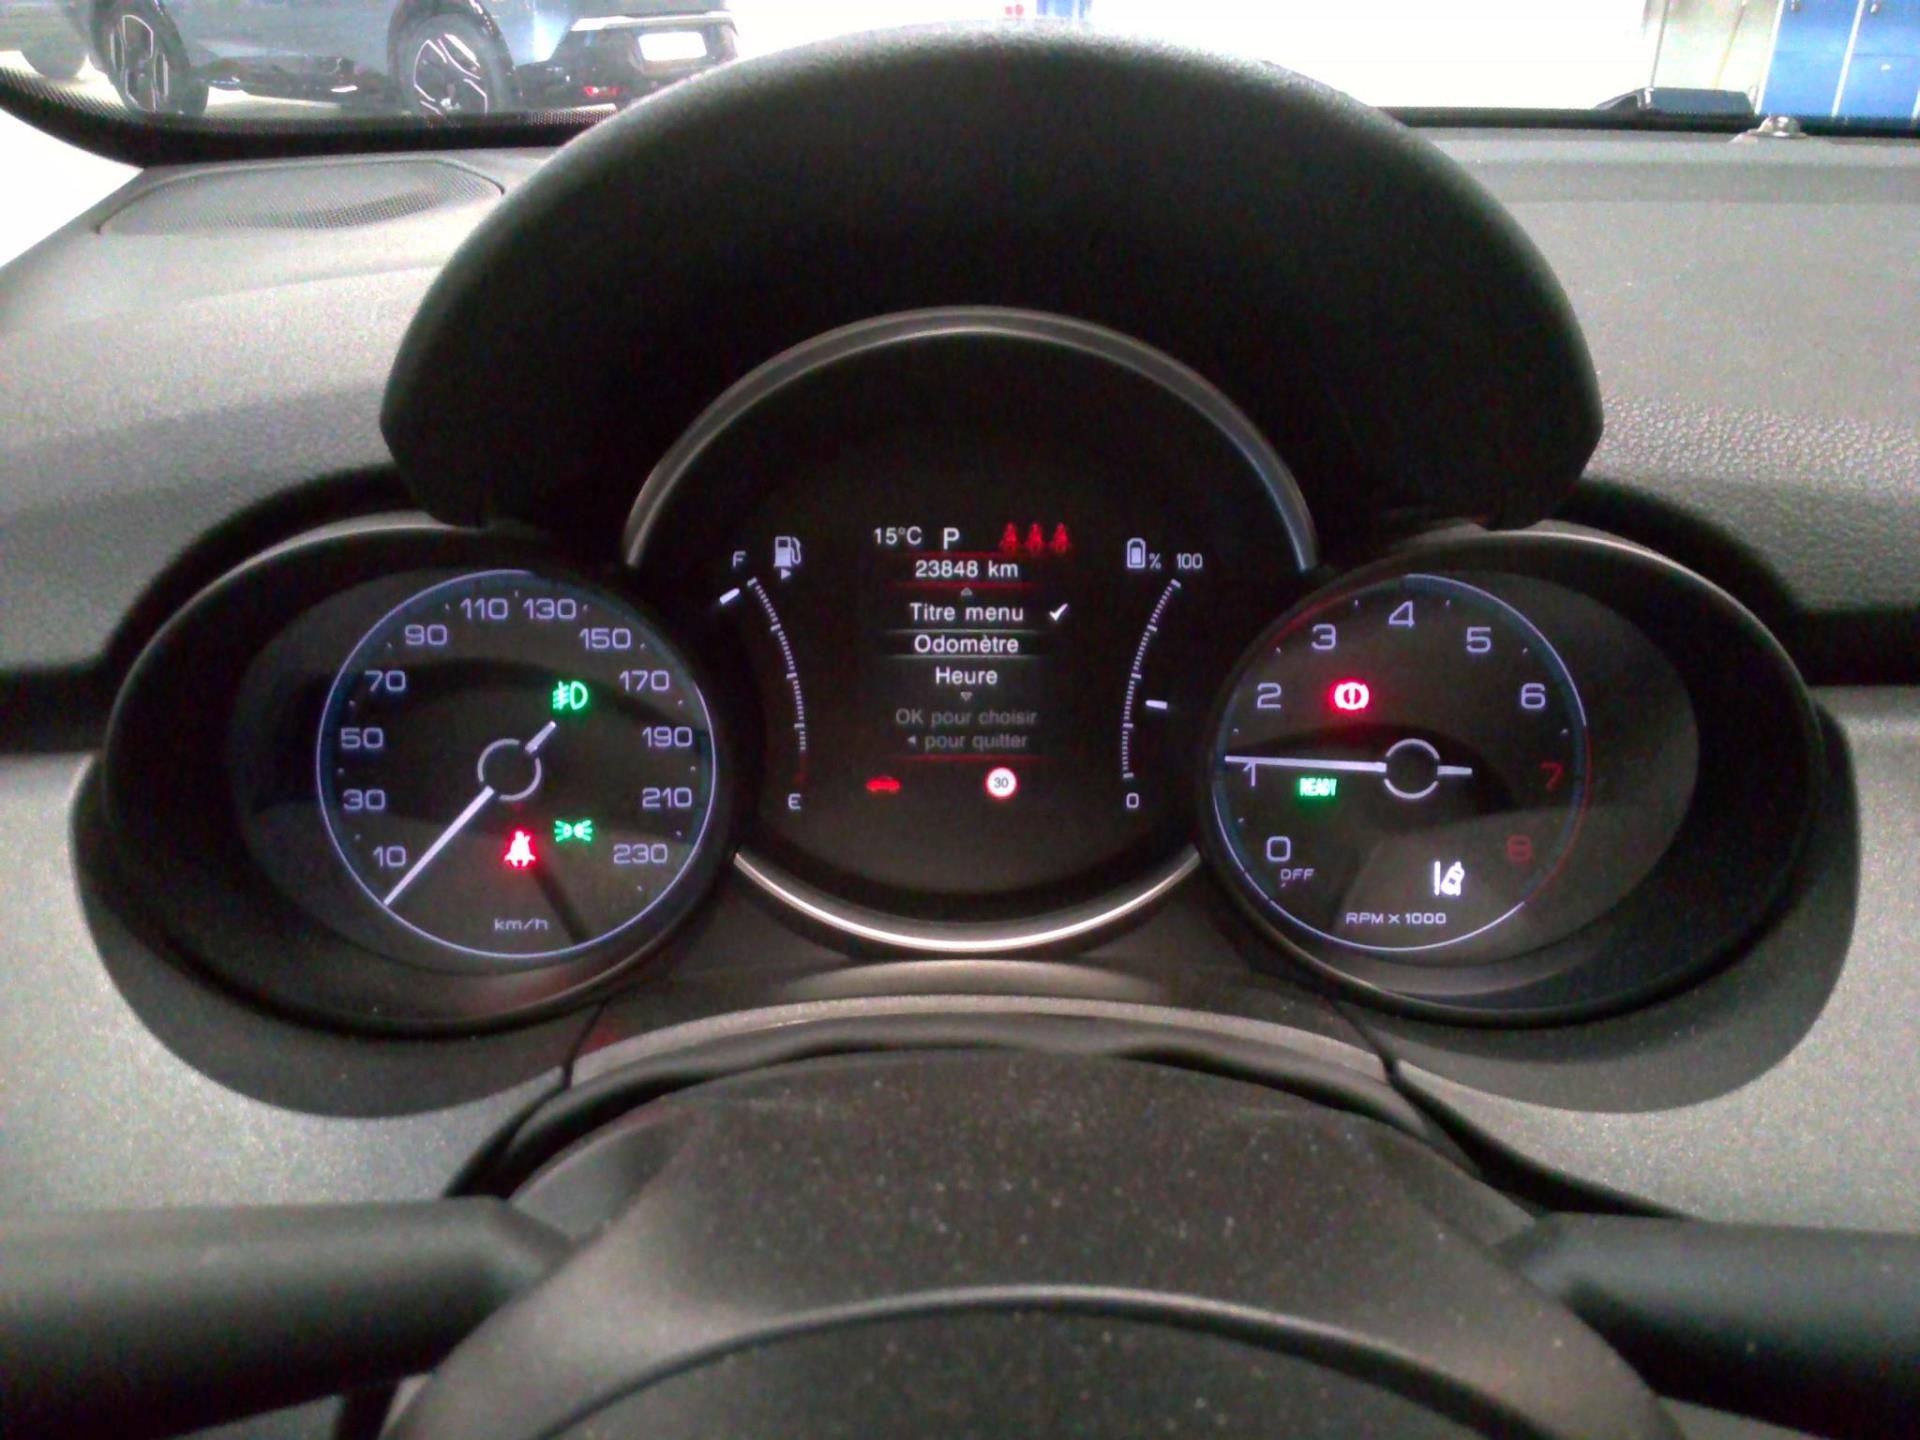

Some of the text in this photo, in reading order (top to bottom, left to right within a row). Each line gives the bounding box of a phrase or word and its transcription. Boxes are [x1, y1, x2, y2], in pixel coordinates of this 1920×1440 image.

[874, 526, 959, 549] 15°C P
[732, 551, 745, 567] F
[915, 560, 1019, 578] 23848 km
[1176, 553, 1203, 569] 100
[460, 598, 508, 620] 110
[523, 598, 577, 620] 130
[911, 604, 1024, 622] Titre menu
[1388, 600, 1415, 628] 4
[404, 624, 448, 646] 90
[579, 628, 631, 649] 150
[914, 635, 1019, 654] Odomètre
[1312, 623, 1336, 650] 3
[1466, 626, 1492, 653] 5
[364, 670, 407, 692] 70
[619, 670, 670, 692] 170
[935, 668, 998, 685] Heure
[1256, 682, 1281, 709] 2
[1521, 683, 1546, 710] 6
[896, 708, 1037, 728] OK pour choisir
[340, 727, 384, 748] 50
[642, 726, 693, 748] 190
[924, 732, 1028, 751] pour quitter
[993, 776, 1009, 790] 30
[1243, 759, 1255, 786] 1
[1541, 763, 1563, 789] 7
[343, 789, 386, 811] 30
[642, 787, 692, 808] 210
[788, 794, 802, 809] E
[372, 845, 407, 867] 10
[613, 843, 668, 864] 230
[1266, 836, 1290, 862] 0
[1506, 835, 1532, 862] 8
[1280, 867, 1315, 882] OFF
[494, 918, 548, 931] km/h
[1346, 912, 1384, 924] RPM
[1405, 912, 1446, 924] 1000
